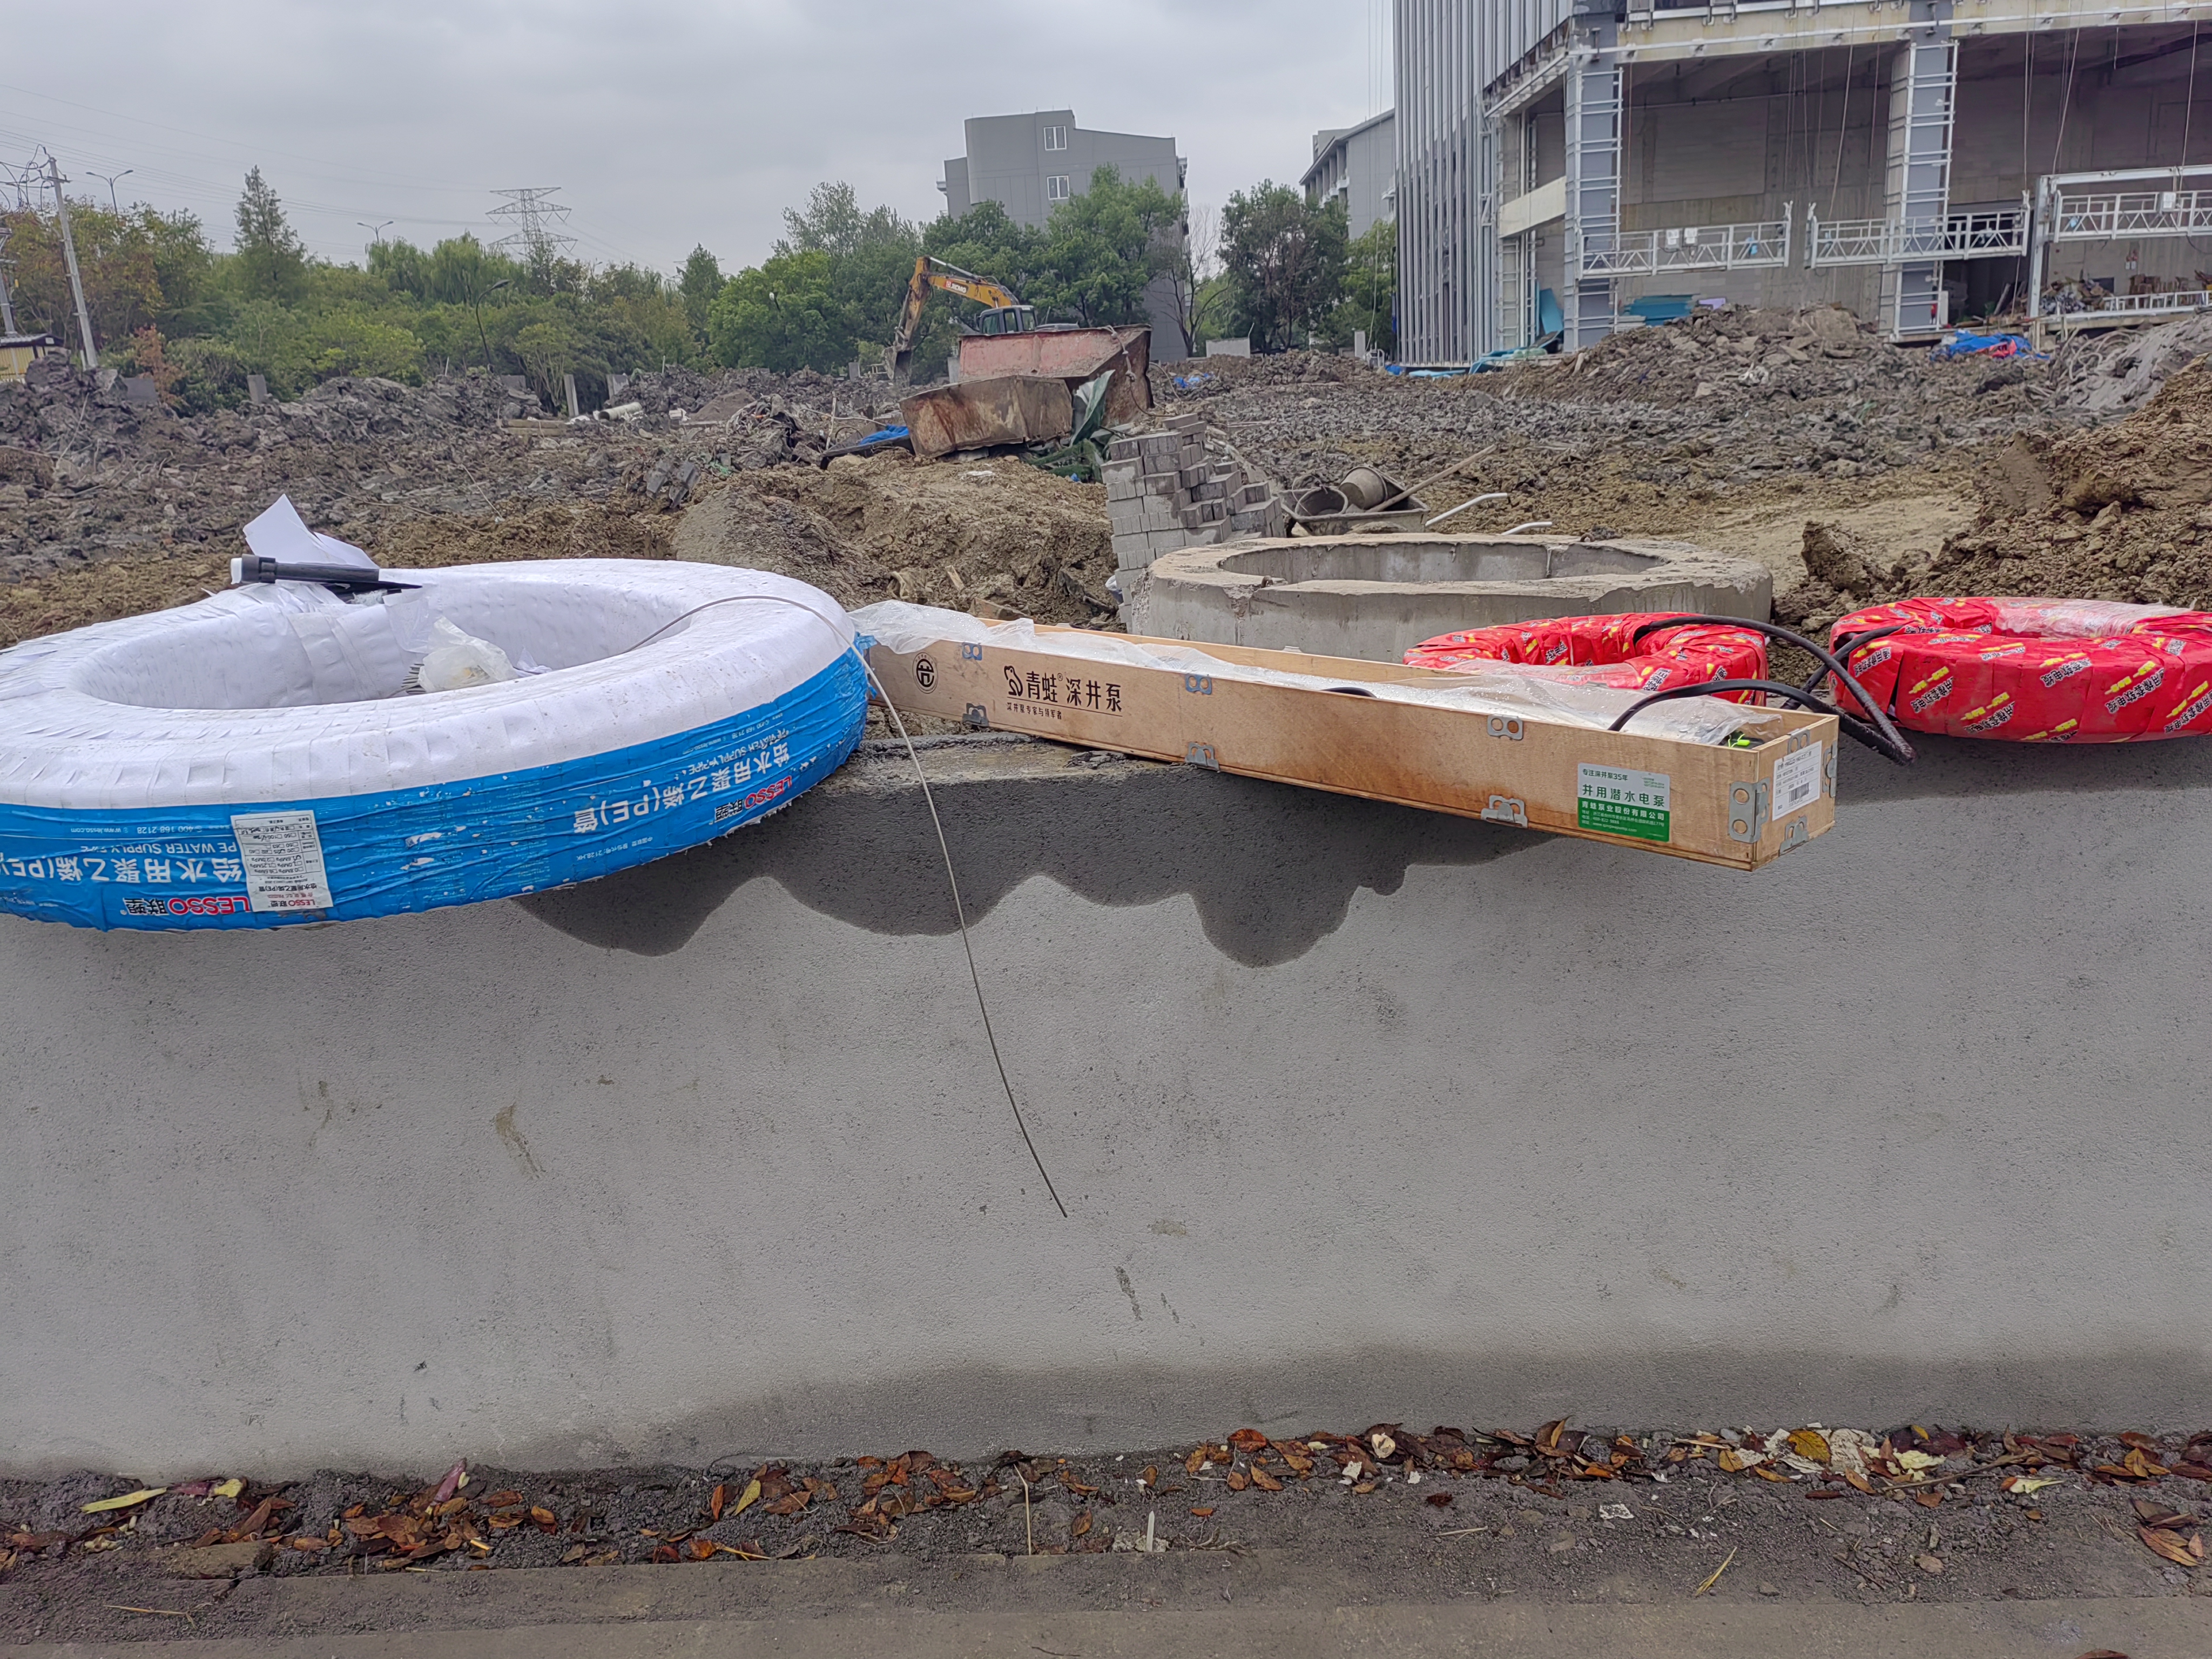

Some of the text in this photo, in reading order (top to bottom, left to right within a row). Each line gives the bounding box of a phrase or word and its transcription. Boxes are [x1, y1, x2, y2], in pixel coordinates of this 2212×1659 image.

[1026, 671, 1122, 712] 青蛙 深井泵
[1910, 676, 1954, 713] 用橡套软电缆
[1582, 768, 1628, 781] 专注深井泵35年
[573, 742, 790, 833] 给水用聚乙烯(PE)管
[744, 775, 793, 810] LESSO
[1582, 784, 1665, 807] 井用潜水电泵
[1582, 801, 1664, 821] 青蛙泵业股份有限公司
[111, 843, 161, 854] SUPPLY
[166, 842, 216, 854] WATER
[220, 842, 238, 852] PE
[0, 856, 242, 884] 给水用聚乙烯(PE)
[124, 896, 250, 916] LESSO 联塑
